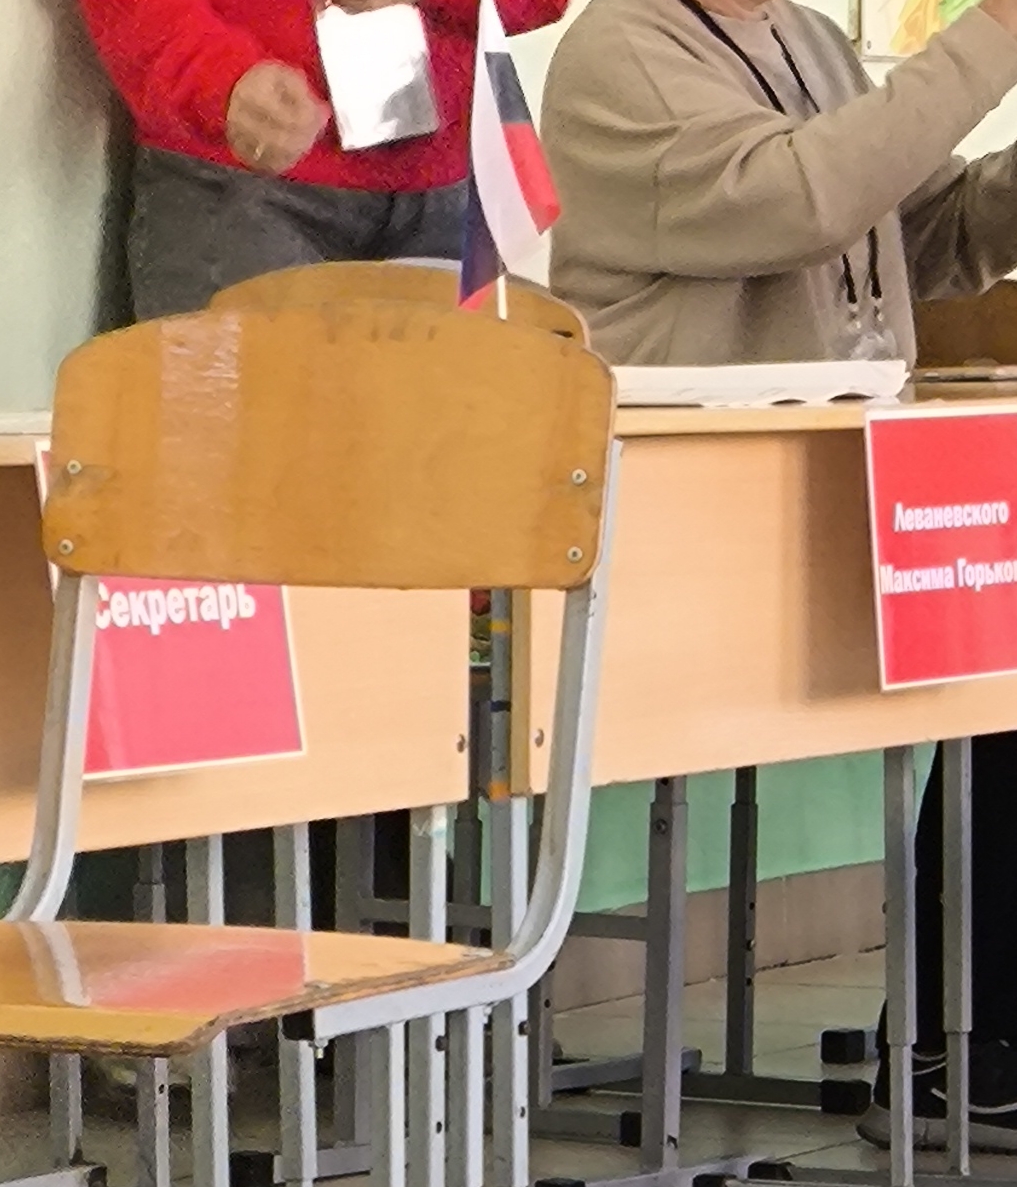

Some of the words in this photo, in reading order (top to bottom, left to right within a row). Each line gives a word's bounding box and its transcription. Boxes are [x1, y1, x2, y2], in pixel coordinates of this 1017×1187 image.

[893, 501, 1010, 533] Леваневского
[879, 564, 956, 595] Максима
[95, 581, 256, 636] Секретарь
